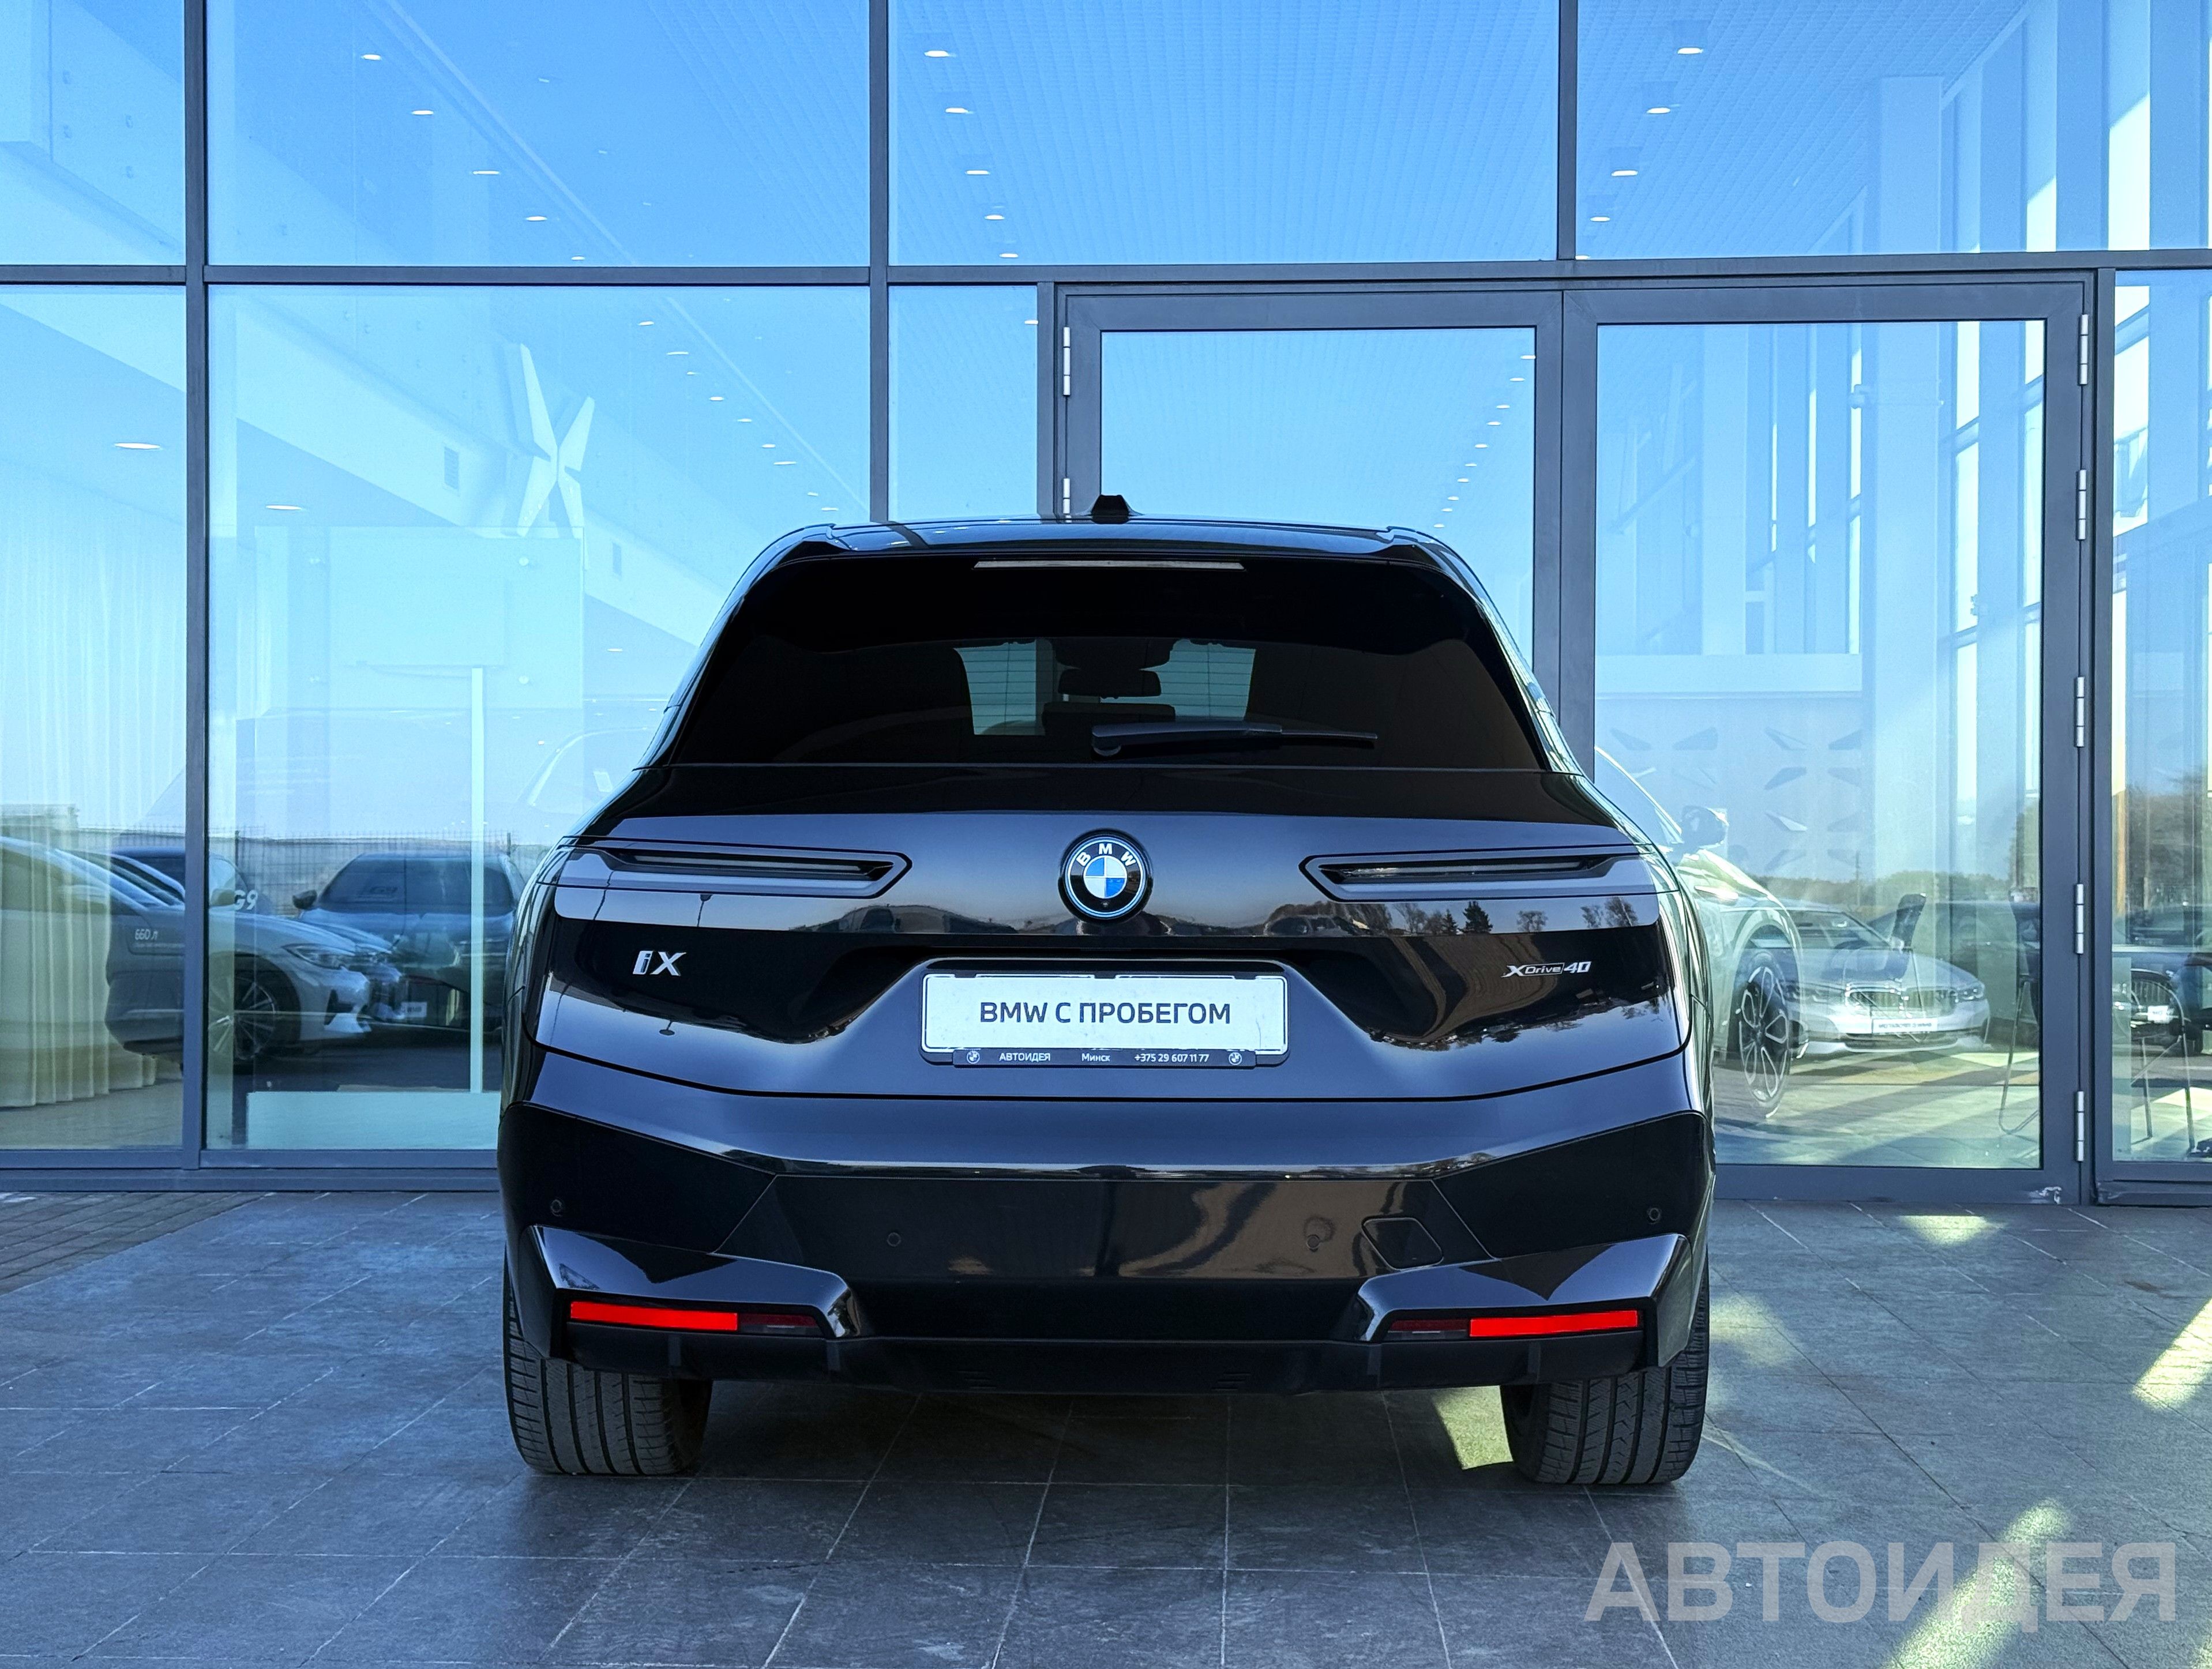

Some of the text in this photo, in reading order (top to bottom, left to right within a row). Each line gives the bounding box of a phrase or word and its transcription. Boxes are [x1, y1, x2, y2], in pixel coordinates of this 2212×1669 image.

[1076, 843, 1136, 866] BMW
[134, 929, 151, 941] 660
[980, 1002, 1230, 1025] BMW С ПРОБЕГОМ
[999, 1052, 1210, 1063] АВТОИДЕЯ Минск +375 29 607 11 77
